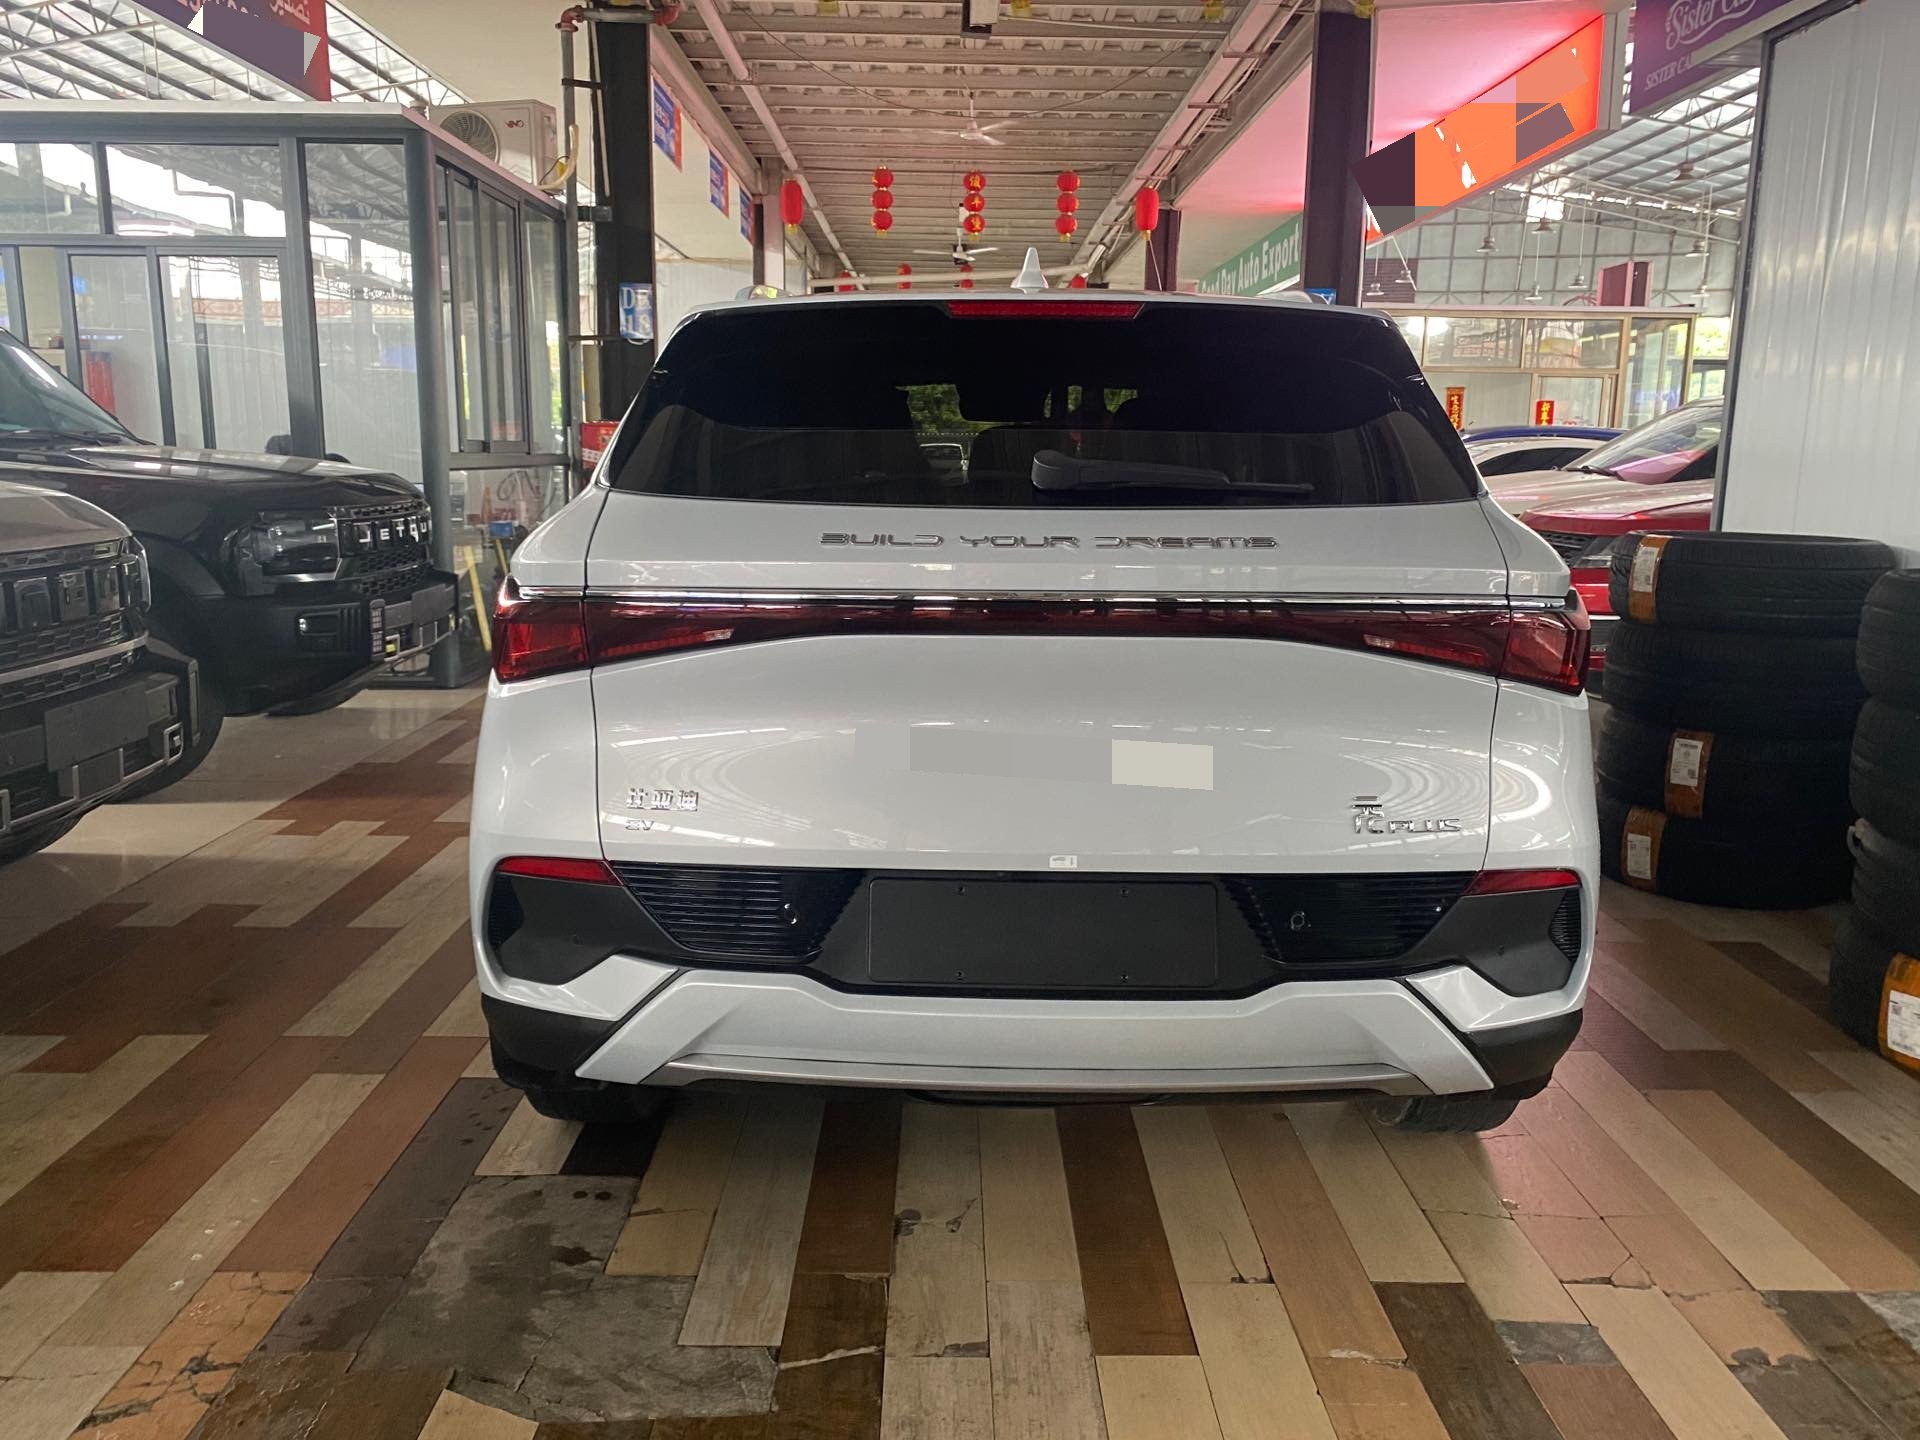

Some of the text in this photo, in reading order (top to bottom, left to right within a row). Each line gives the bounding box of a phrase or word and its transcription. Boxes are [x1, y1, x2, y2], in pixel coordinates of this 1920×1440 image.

[1666, 0, 1716, 50] Sister
[1644, 62, 1678, 91] SISTER
[1221, 268, 1237, 295] Day
[1237, 251, 1260, 293] Auto
[1261, 222, 1300, 281] Export
[359, 521, 428, 543] JETOU
[820, 533, 1278, 549] BUILD YOUR DREAMS
[625, 819, 655, 832] EV
[1351, 795, 1461, 834] 元 PLUS
